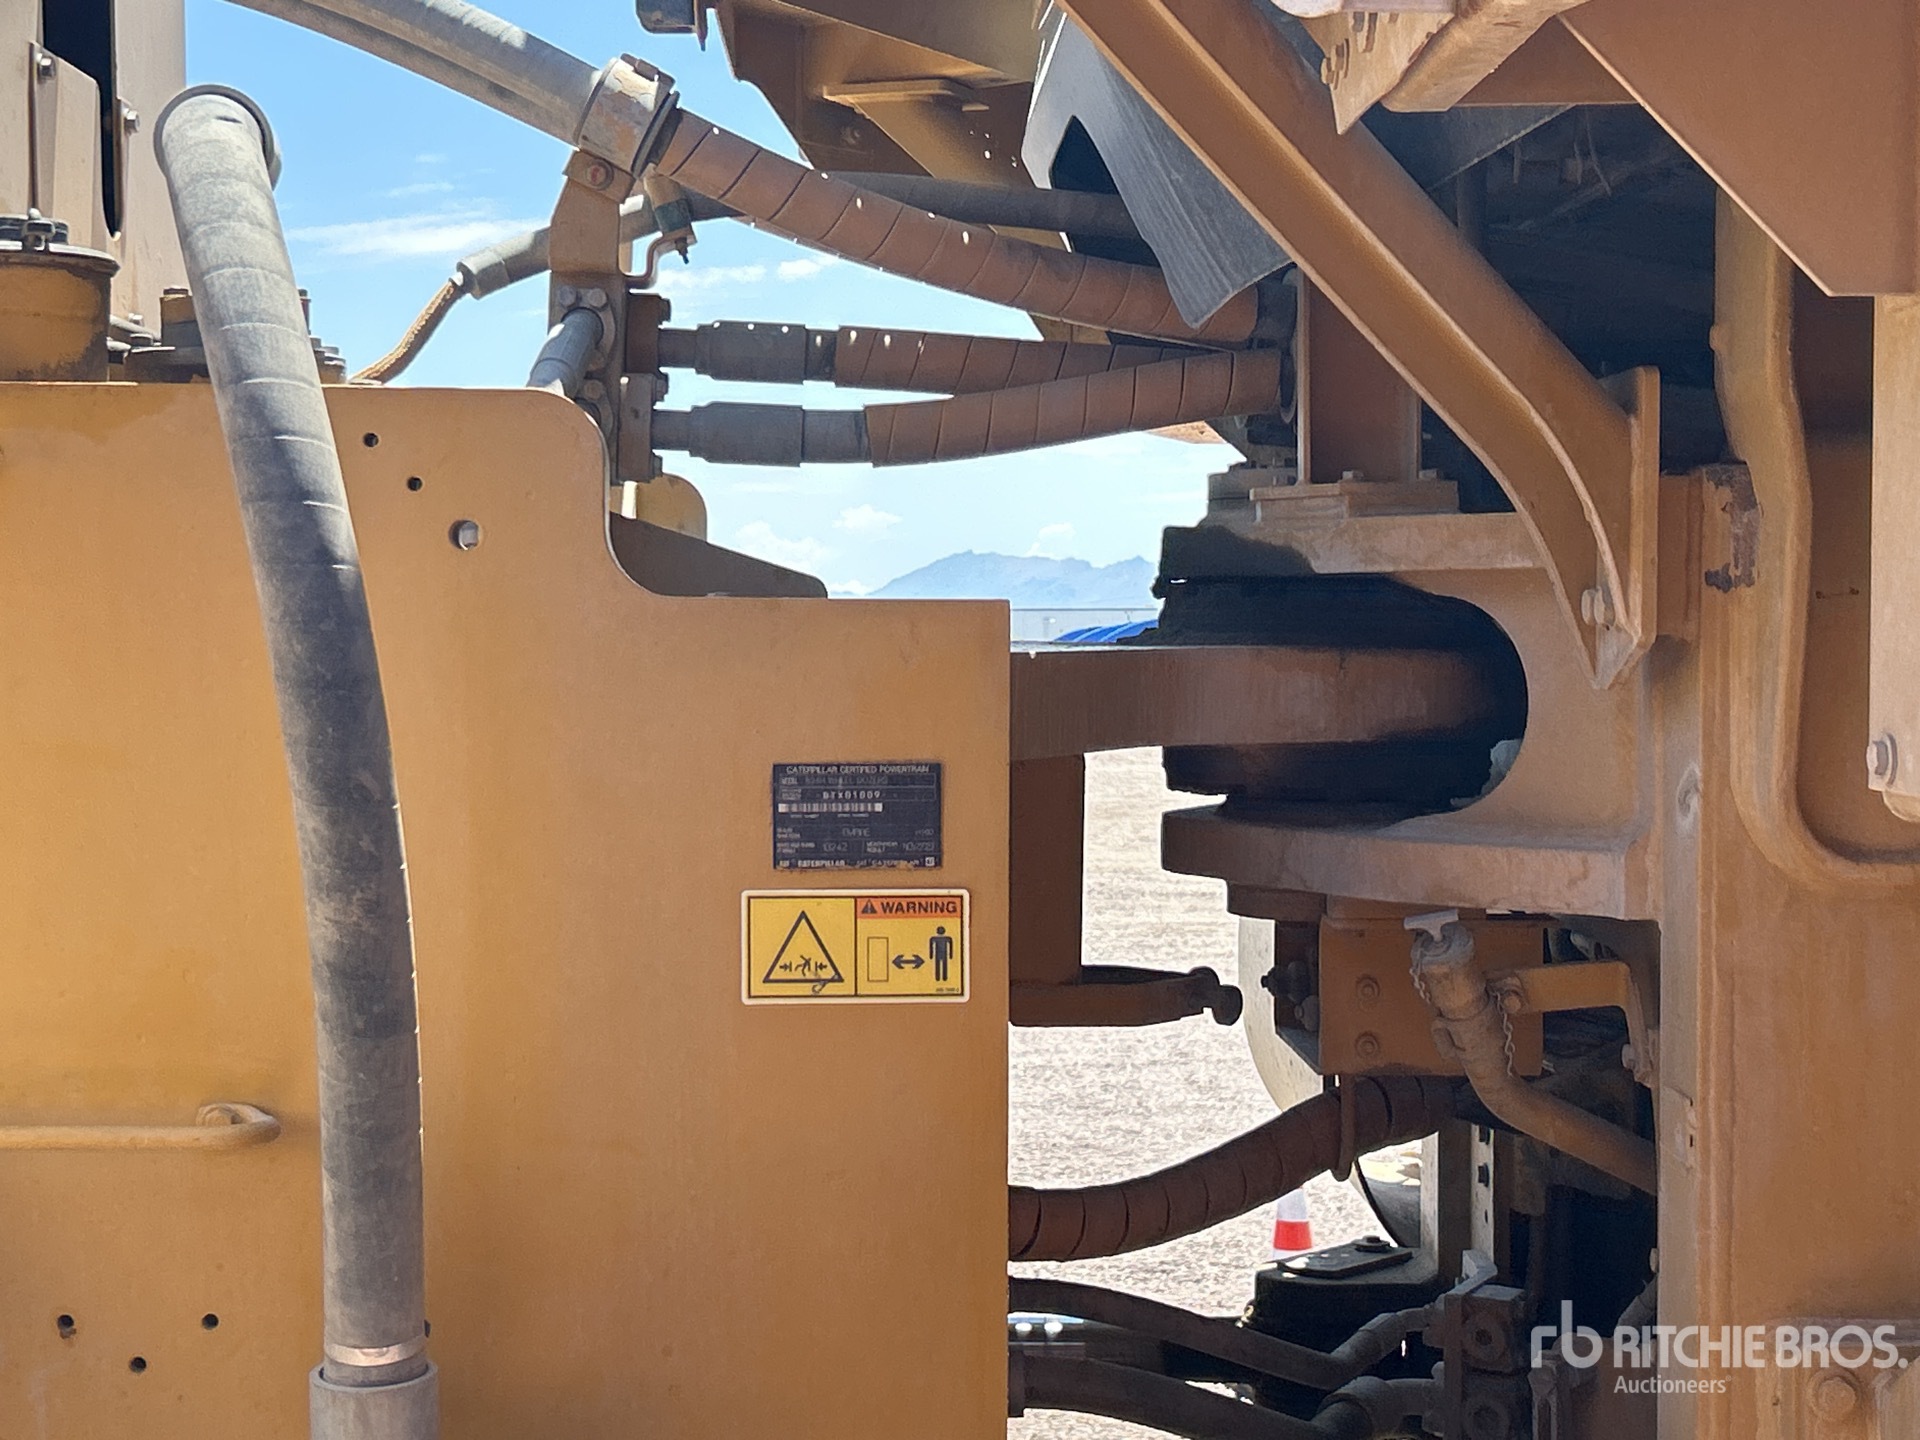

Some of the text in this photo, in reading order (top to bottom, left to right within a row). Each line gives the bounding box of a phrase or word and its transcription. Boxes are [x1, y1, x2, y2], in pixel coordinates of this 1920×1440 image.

[786, 765, 930, 774] CATERPILLAR CERTIFIED POWERTRAIN
[880, 901, 958, 914] WARNING
